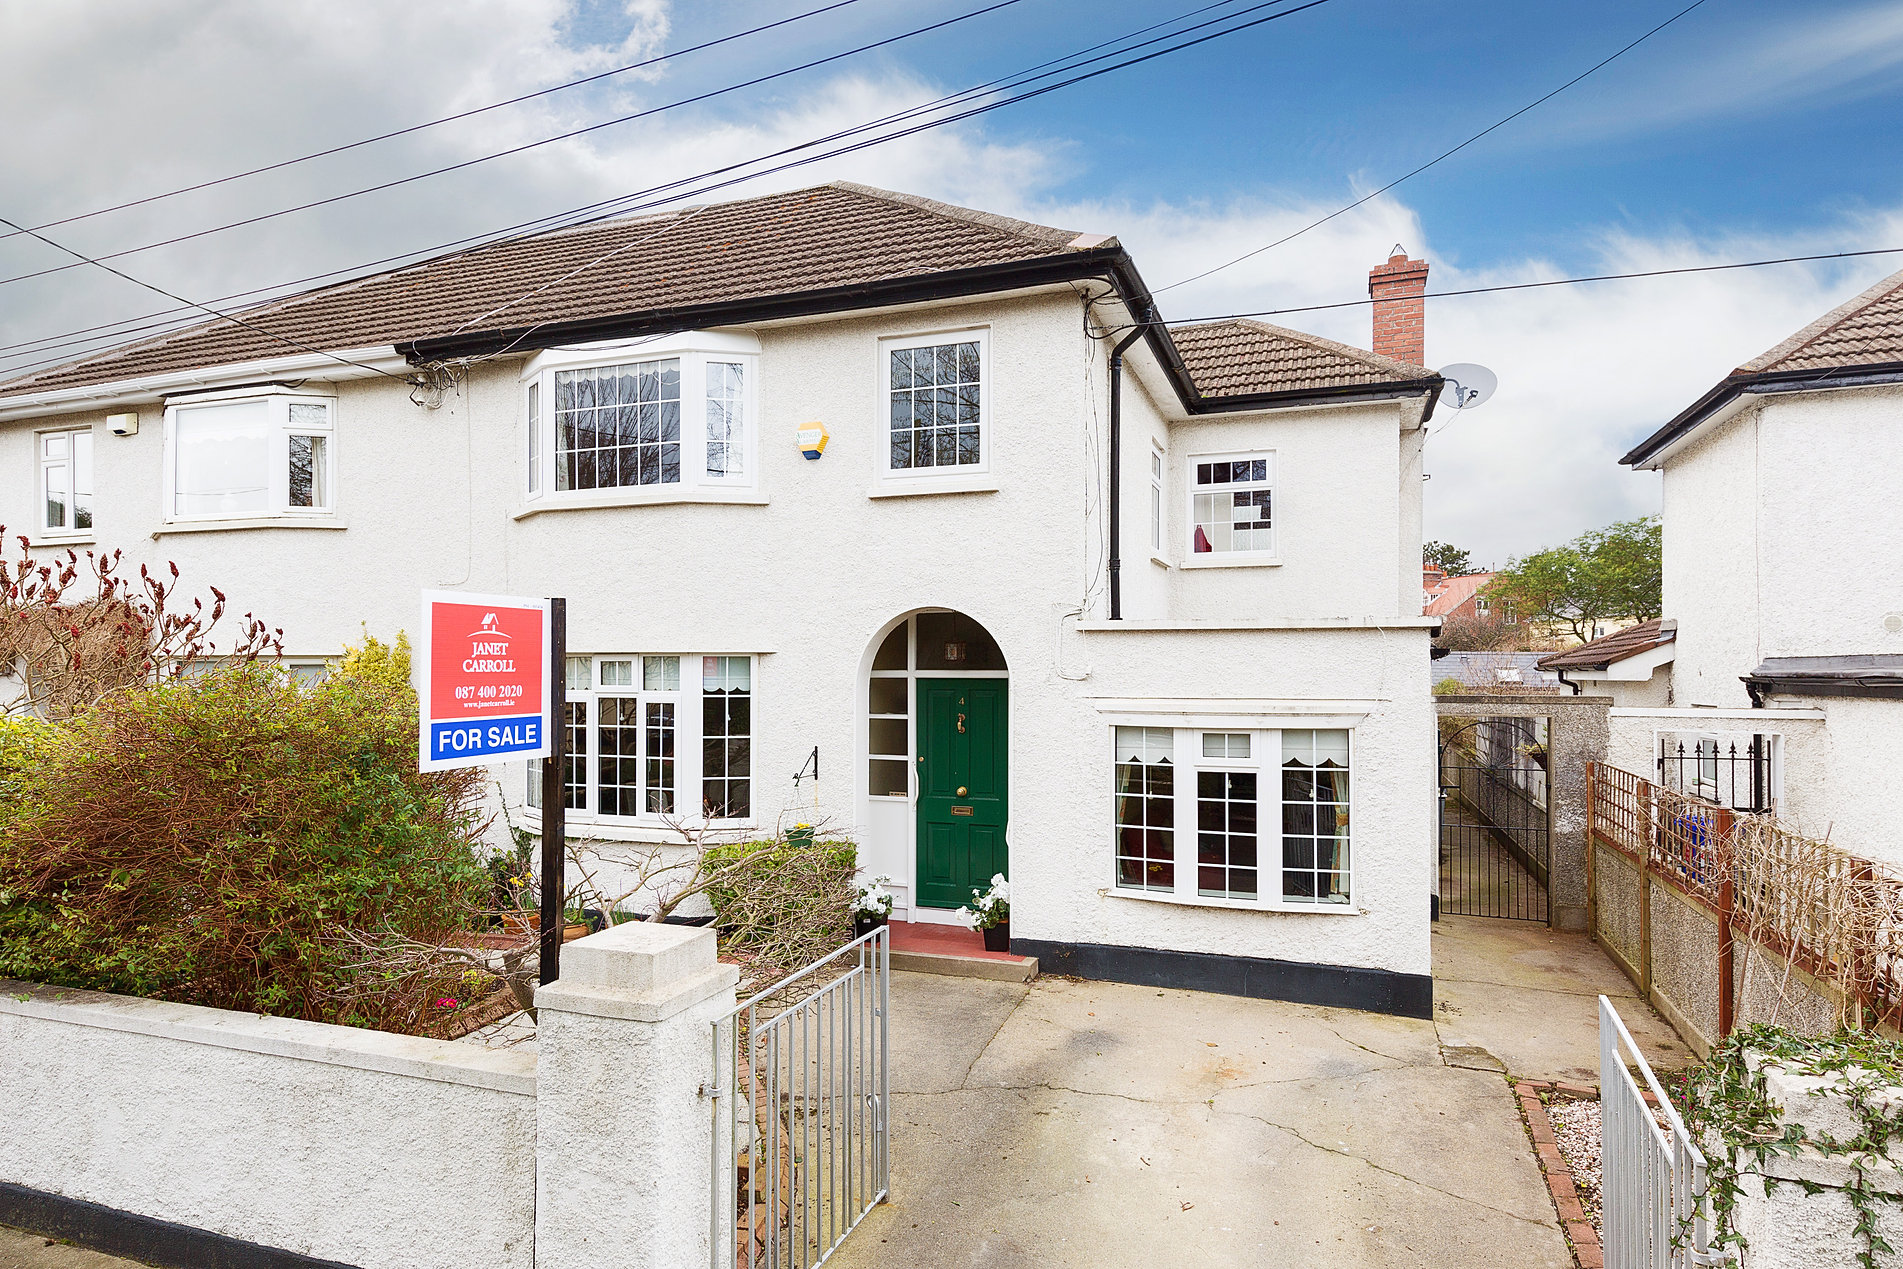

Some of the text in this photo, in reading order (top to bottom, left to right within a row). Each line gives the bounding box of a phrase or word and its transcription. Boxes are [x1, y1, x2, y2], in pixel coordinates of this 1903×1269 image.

[471, 642, 509, 657] JANET
[462, 660, 516, 672] CARROLL
[455, 685, 523, 699] 087 400 2020
[463, 700, 515, 708] www.janetcarroll.ie
[439, 724, 537, 752] FOR SALE
